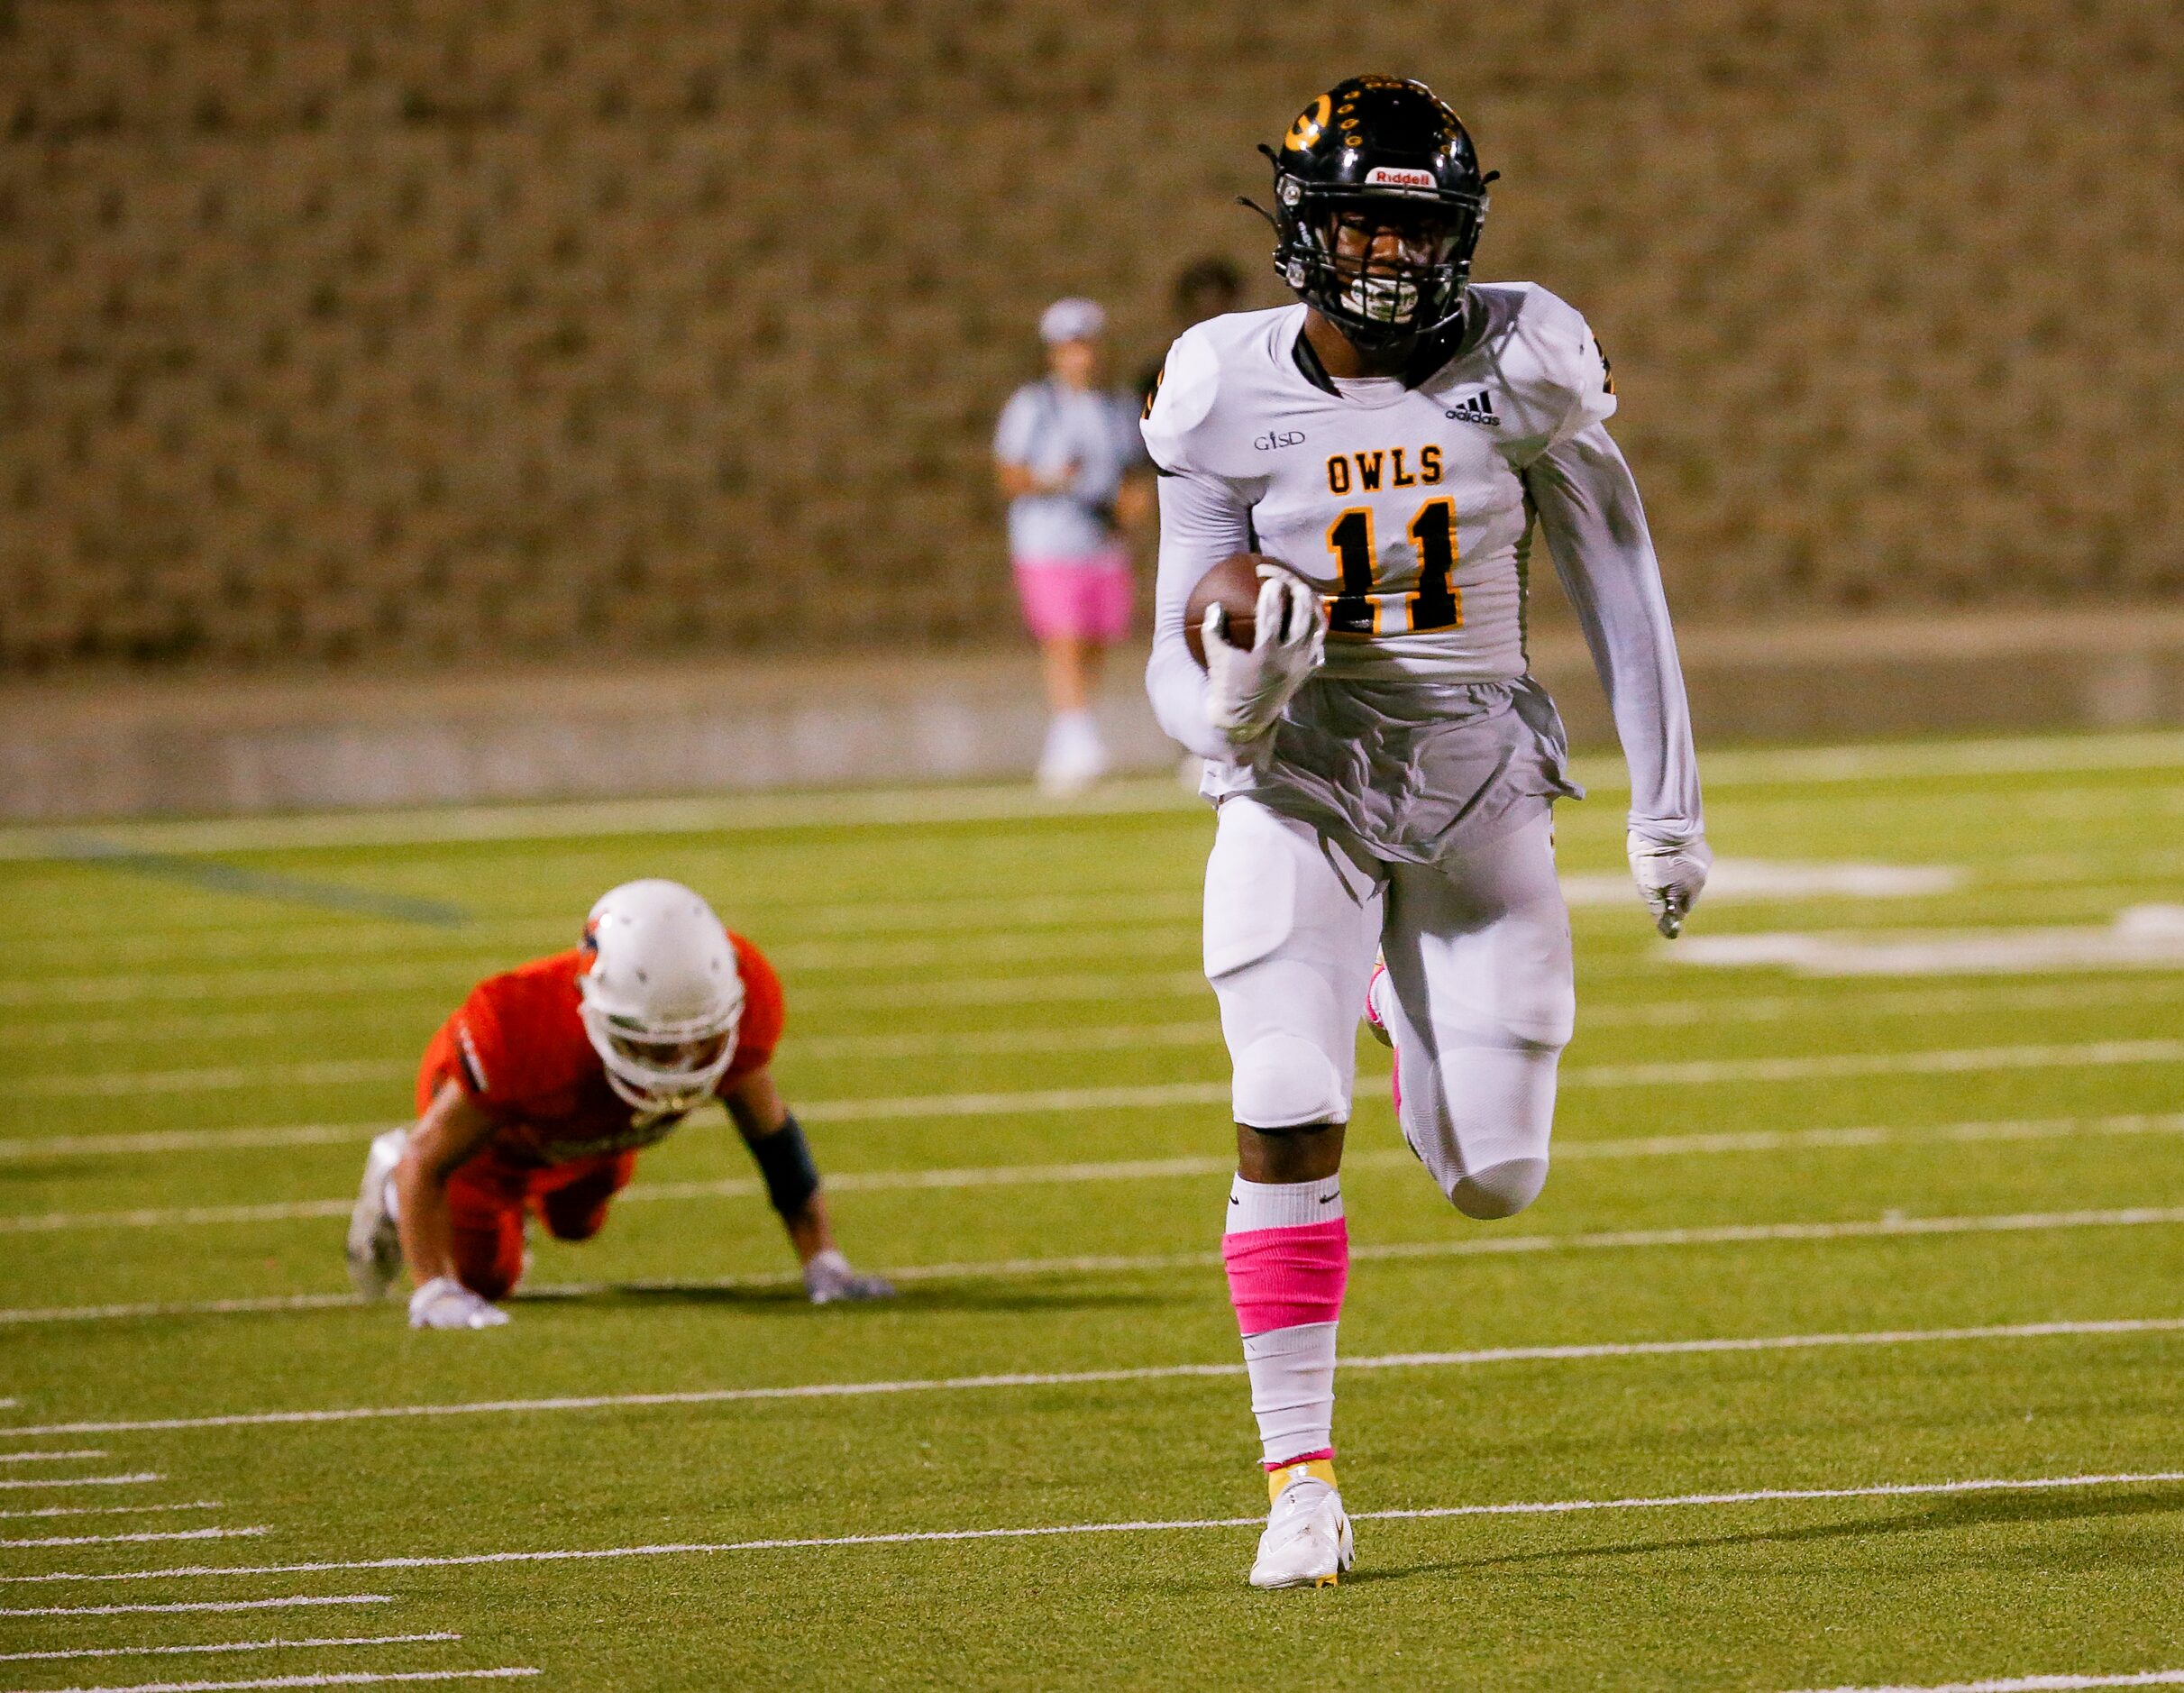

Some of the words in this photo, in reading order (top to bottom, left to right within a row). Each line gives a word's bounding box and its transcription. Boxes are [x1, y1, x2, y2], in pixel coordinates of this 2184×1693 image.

[1375, 170, 1430, 186] Riddell
[1445, 408, 1501, 426] adidas
[1327, 444, 1443, 495] OWLS
[1323, 495, 1464, 636] 11
